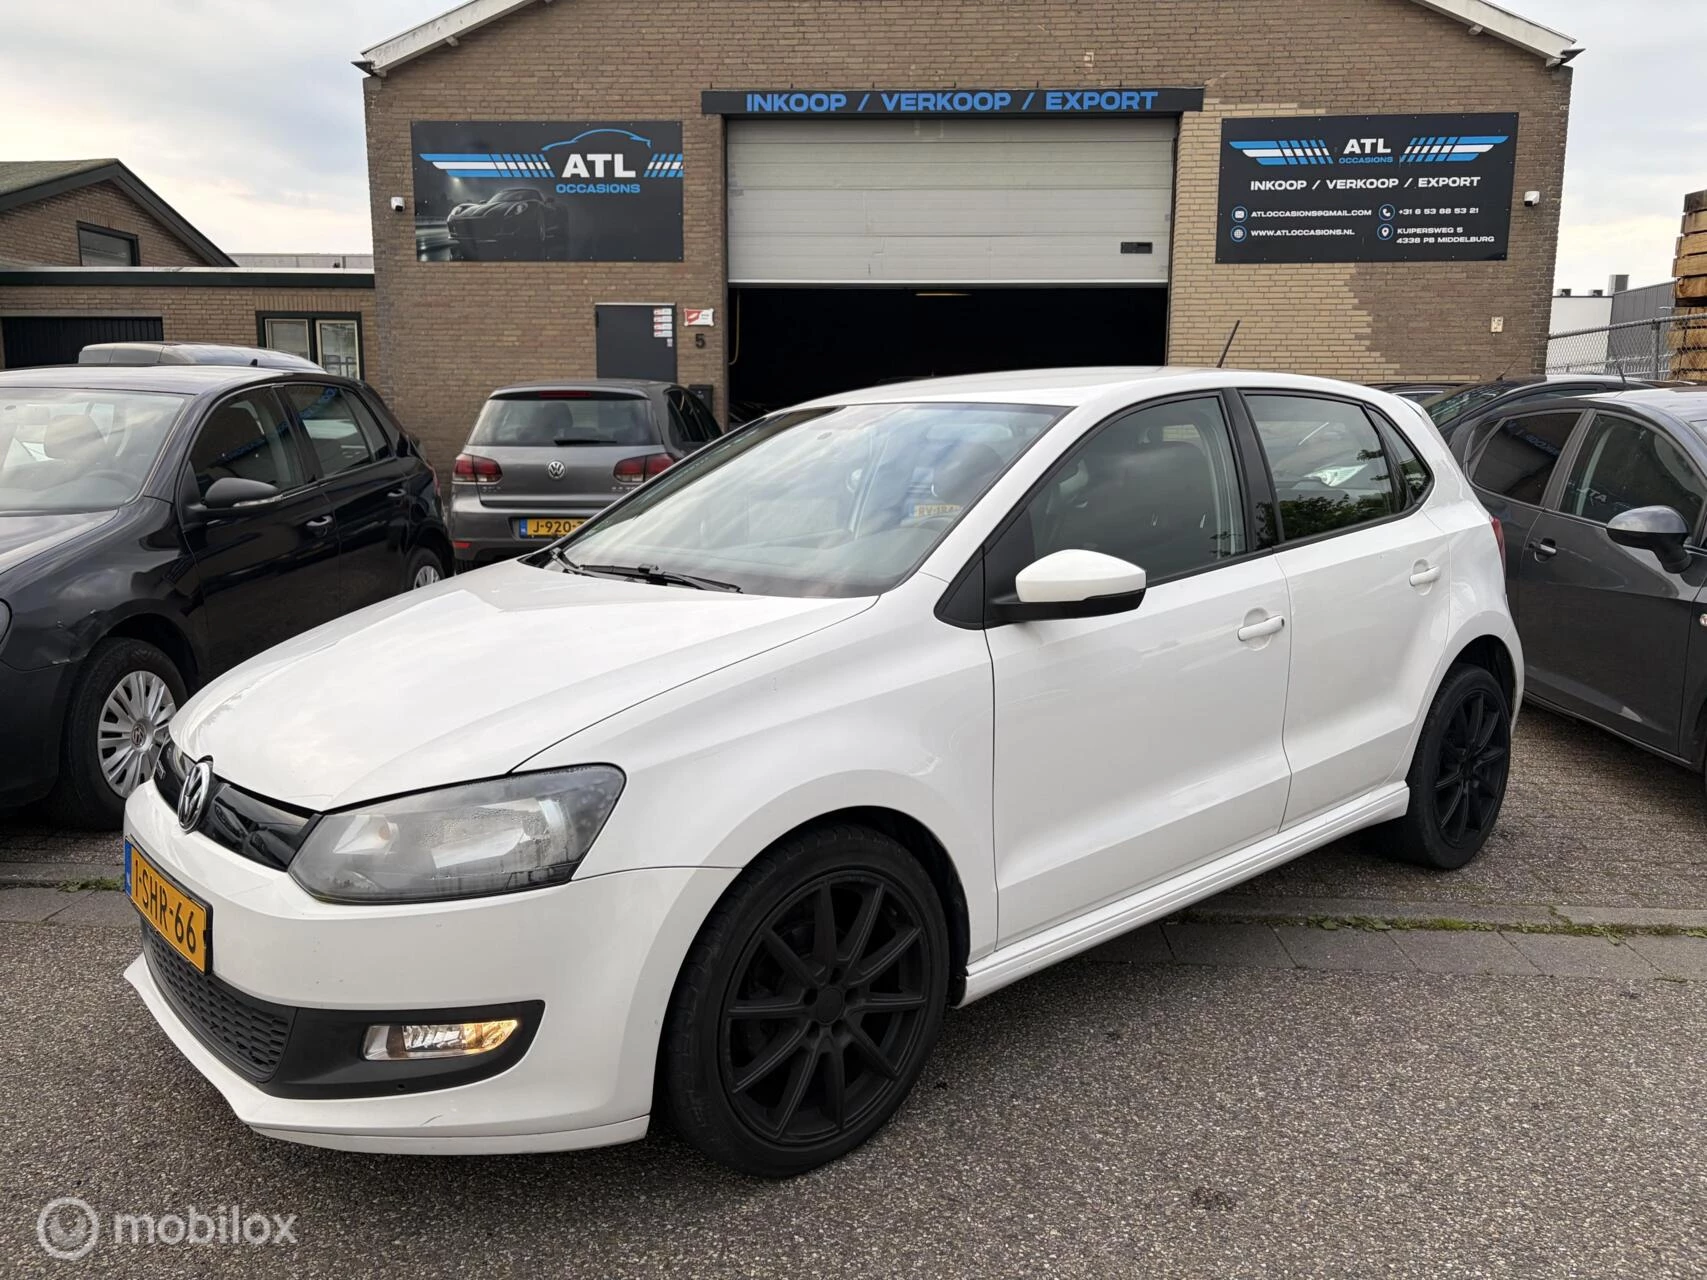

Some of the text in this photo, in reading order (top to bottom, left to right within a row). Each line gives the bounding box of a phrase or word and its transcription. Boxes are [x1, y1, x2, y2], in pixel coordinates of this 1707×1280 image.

[746, 91, 1158, 112] INKOOP / VERKOOP / EXPORT
[1343, 138, 1392, 155] ATL
[561, 153, 636, 178] ATL
[1338, 156, 1394, 164] OCCASIONS
[555, 183, 641, 194] OCCASIONS
[1250, 176, 1481, 191] INKOOP / VERKOOP / EXPORT
[1250, 228, 1356, 237] WWW.ATLOCCASIONS.NL
[1396, 226, 1455, 235] KUIPERSWEG
[1437, 235, 1495, 243] MIDDELBURG
[695, 333, 706, 349] 5
